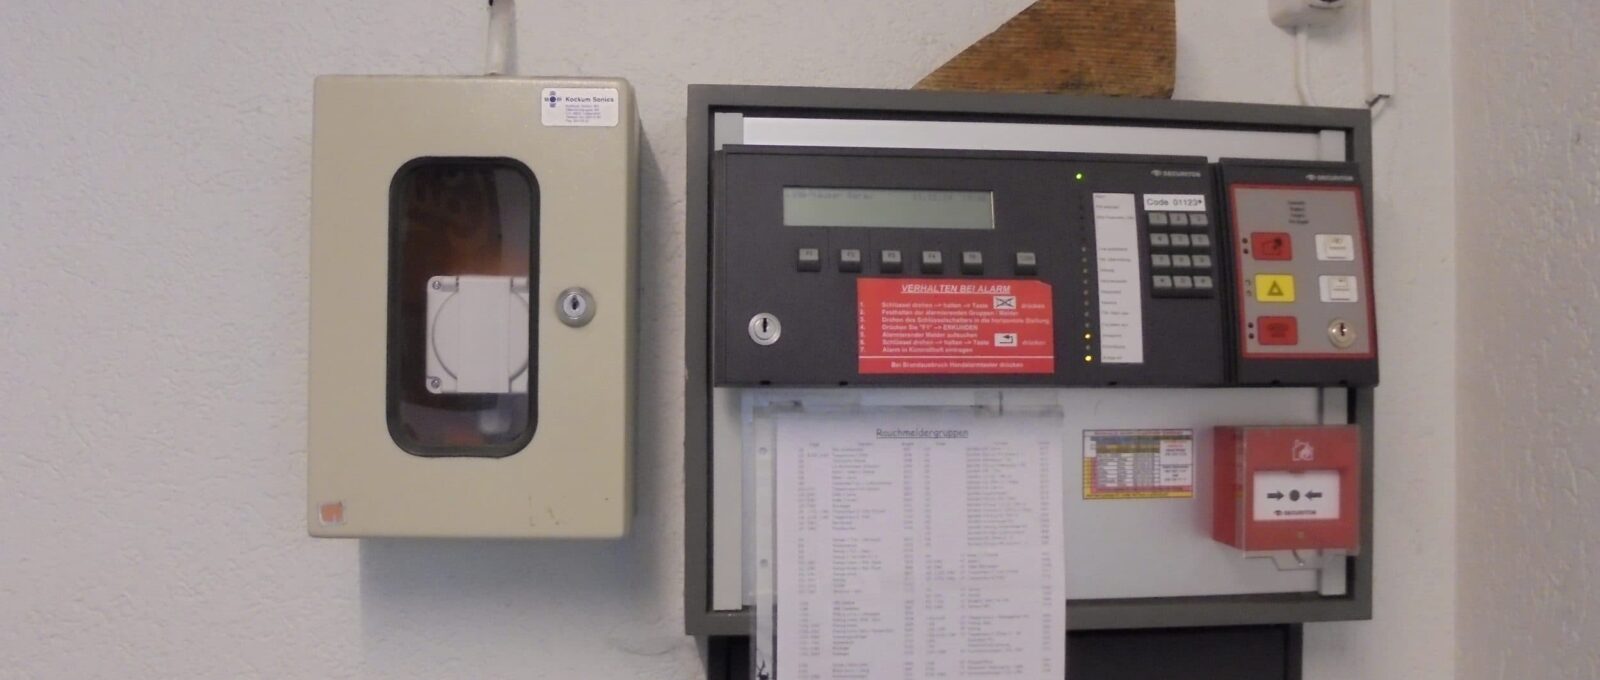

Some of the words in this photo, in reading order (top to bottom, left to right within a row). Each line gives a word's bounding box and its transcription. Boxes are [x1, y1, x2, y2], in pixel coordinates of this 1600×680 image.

[1146, 198, 1169, 206] Code
[901, 283, 958, 294] VERHALTEN
[959, 284, 976, 294] BEI
[977, 285, 1011, 294] ALARM
[876, 428, 969, 439] Rauchmeldergruppen
